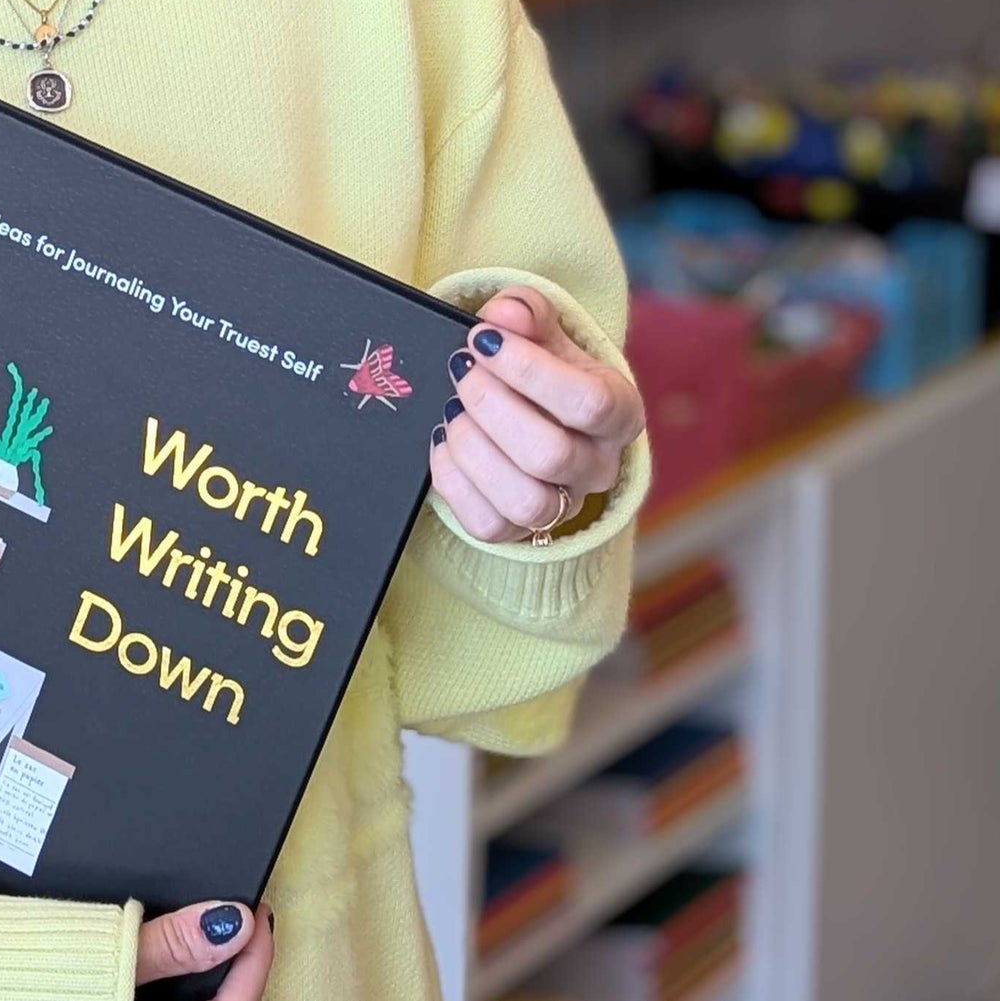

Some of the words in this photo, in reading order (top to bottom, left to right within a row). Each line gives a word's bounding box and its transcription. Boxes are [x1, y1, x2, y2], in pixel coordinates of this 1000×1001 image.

[36, 235, 66, 261] for
[61, 249, 167, 313] Journaling
[171, 296, 215, 332] Your
[219, 318, 280, 362] Truest
[281, 350, 324, 382] Self
[142, 417, 325, 558] Worth
[68, 589, 246, 726] Down
[109, 502, 325, 669] Writing
